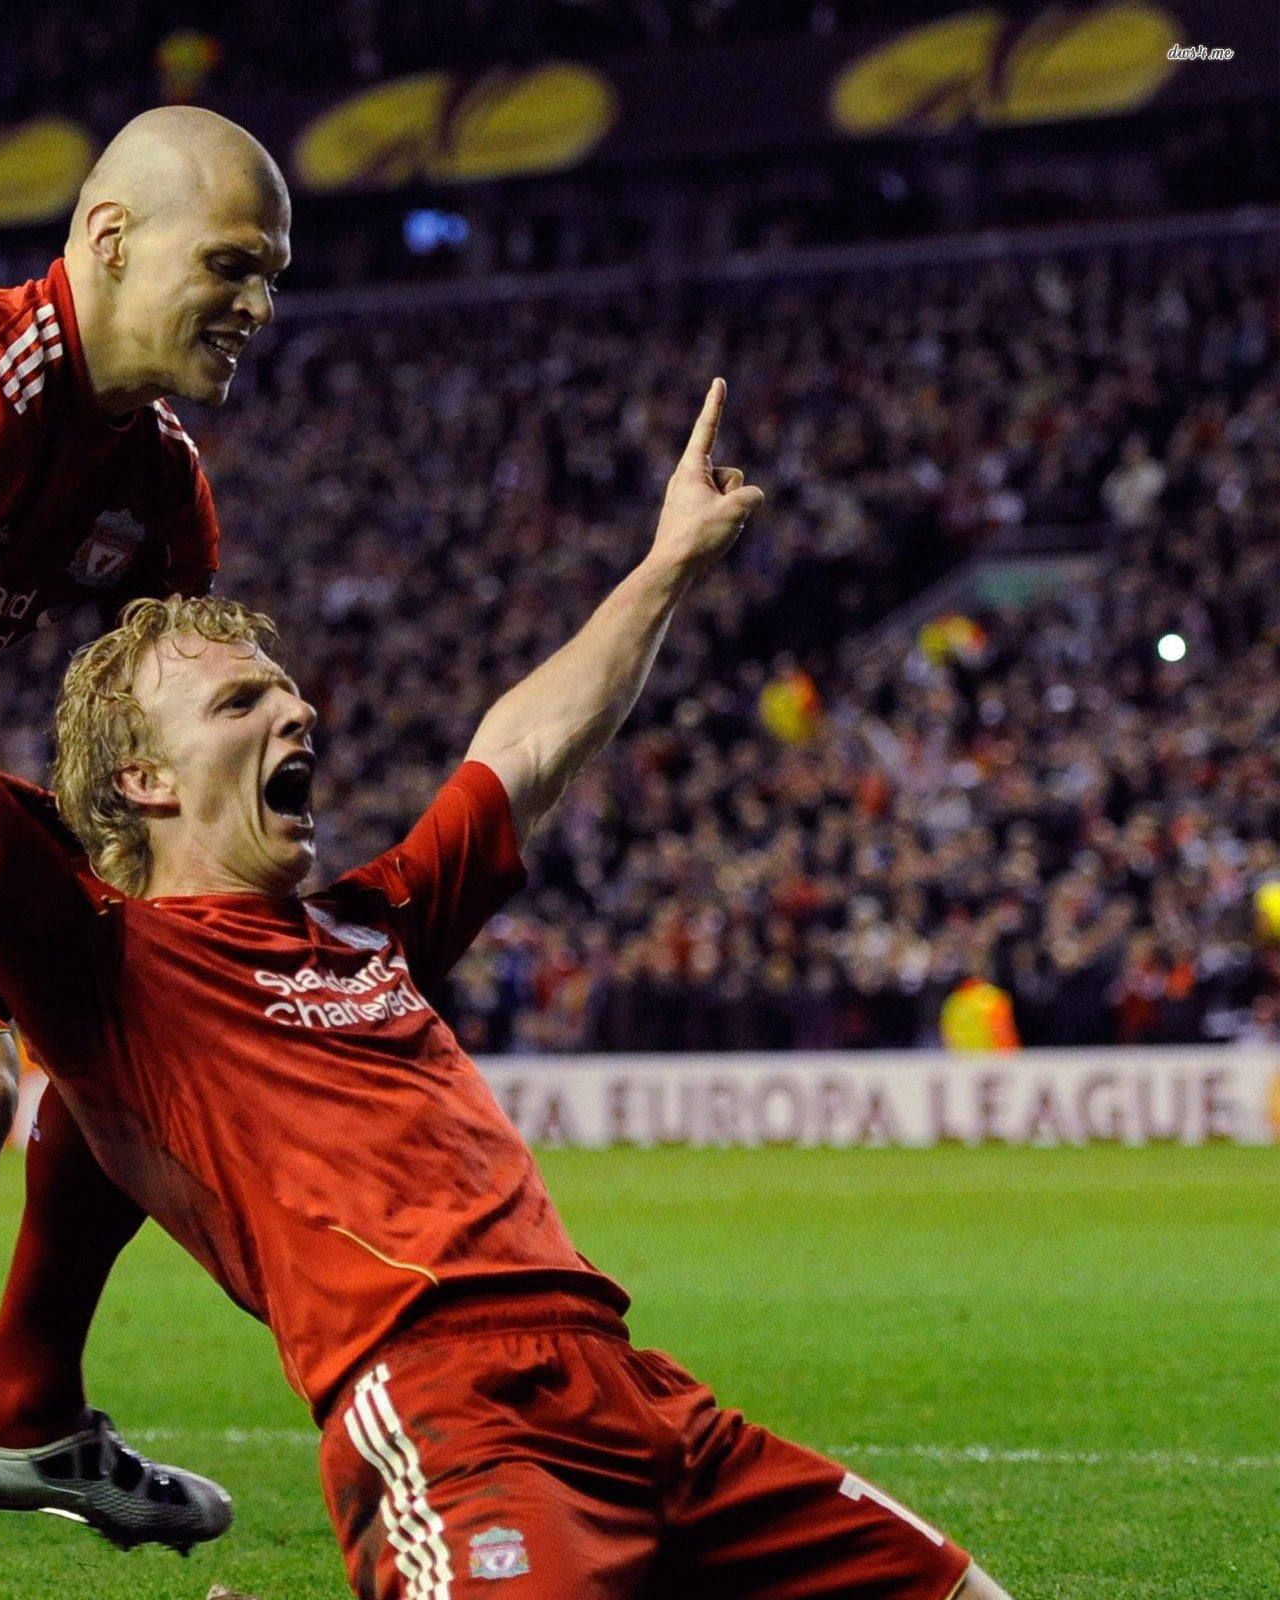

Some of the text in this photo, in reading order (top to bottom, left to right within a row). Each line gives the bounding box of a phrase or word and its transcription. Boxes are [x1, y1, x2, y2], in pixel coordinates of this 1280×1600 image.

[264, 982, 426, 1030] Chartered
[604, 1072, 903, 1143] EUROPA
[926, 1067, 1239, 1143] LEAGUE
